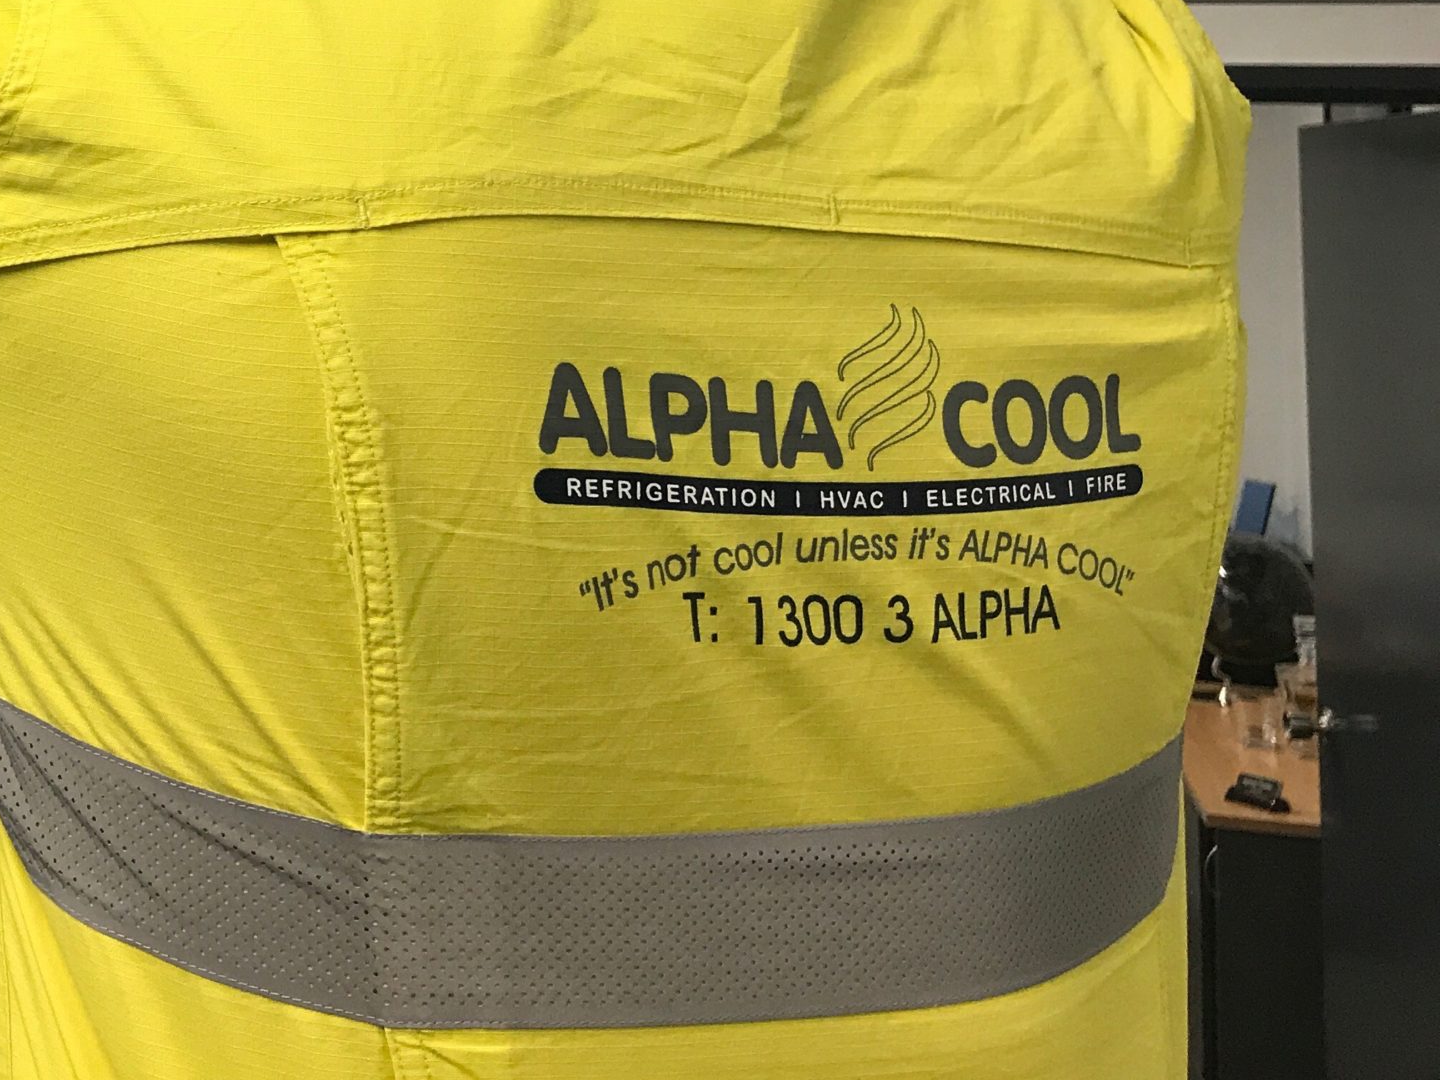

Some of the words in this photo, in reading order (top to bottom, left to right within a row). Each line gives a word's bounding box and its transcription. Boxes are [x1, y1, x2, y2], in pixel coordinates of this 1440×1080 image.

[539, 362, 844, 469] ALPHA
[943, 373, 1142, 468] COOL
[566, 477, 777, 508] REFRIGERATION
[820, 489, 885, 510] HVAC
[926, 482, 1057, 508] ELECTRICAL
[1085, 473, 1127, 494] FIRE
[646, 544, 701, 590] not
[713, 532, 784, 576] cool
[795, 528, 898, 562] unless
[908, 527, 950, 561] it's
[959, 529, 1049, 570] ALPHA
[682, 592, 719, 643] T:
[883, 594, 914, 644] 3
[932, 584, 1061, 644] ALPHA
